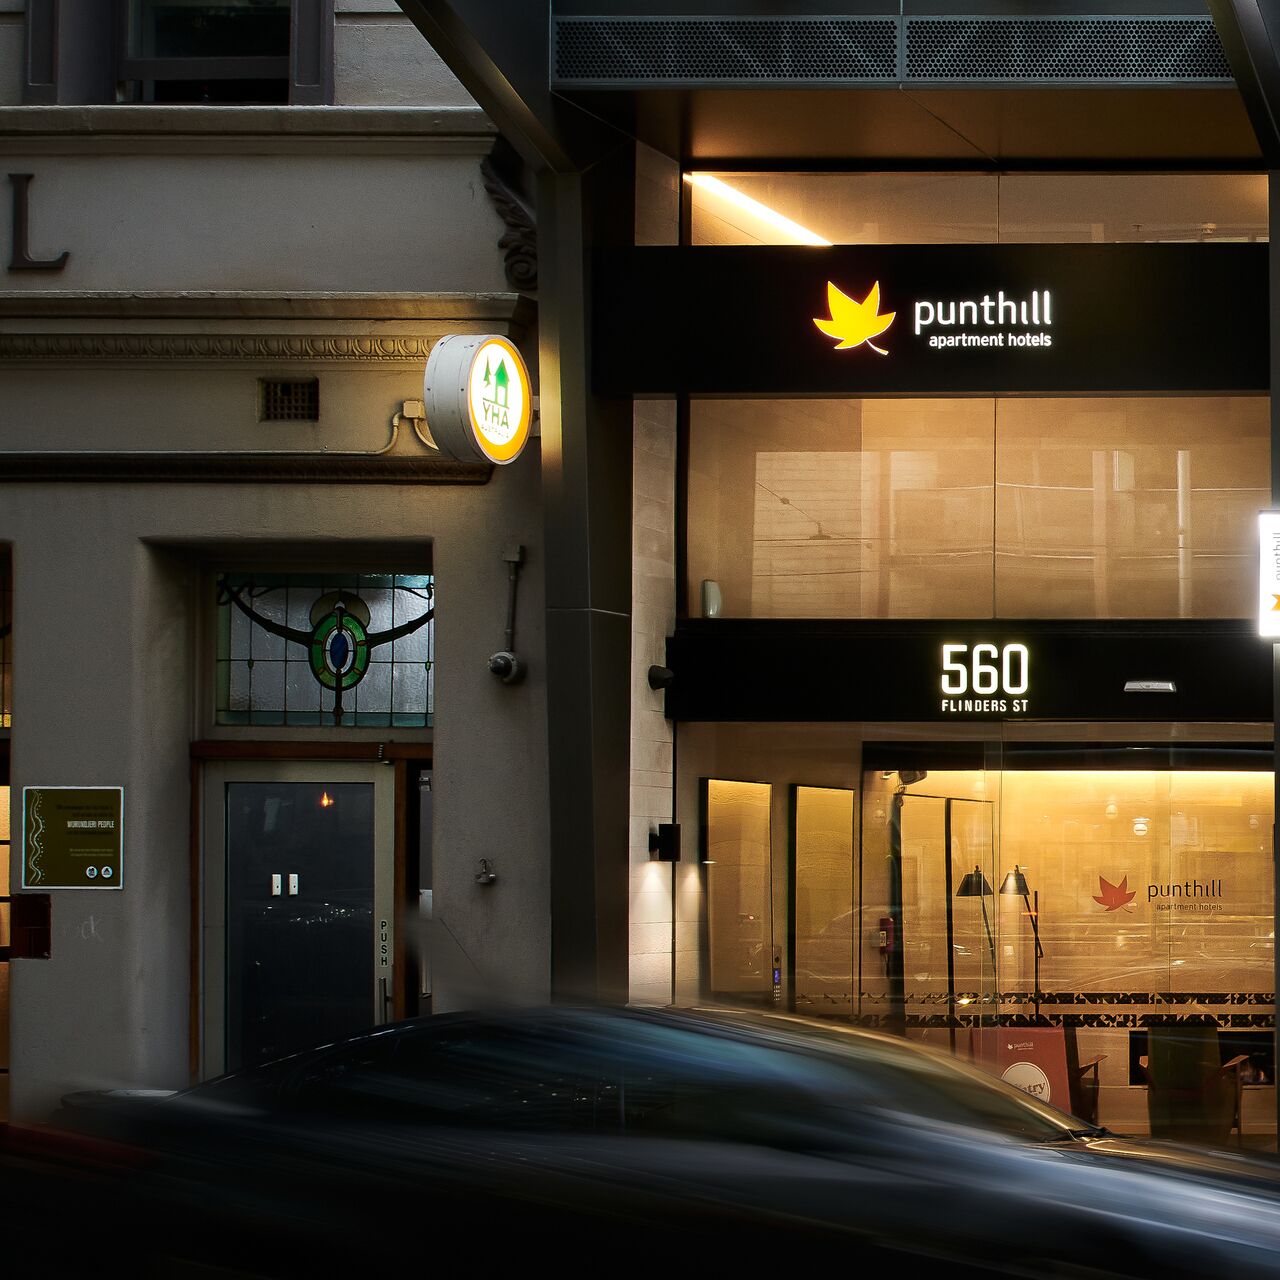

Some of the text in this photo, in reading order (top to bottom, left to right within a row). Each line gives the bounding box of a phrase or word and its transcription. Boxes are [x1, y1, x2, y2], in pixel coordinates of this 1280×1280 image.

[914, 290, 1052, 335] punthill
[929, 332, 1052, 349] apartment hotels
[483, 401, 509, 429] YHA
[941, 644, 1028, 694] 560
[942, 700, 1028, 712] FLINDERS ST
[1148, 880, 1222, 902] punthill
[1156, 903, 1223, 911] apartment hotels
